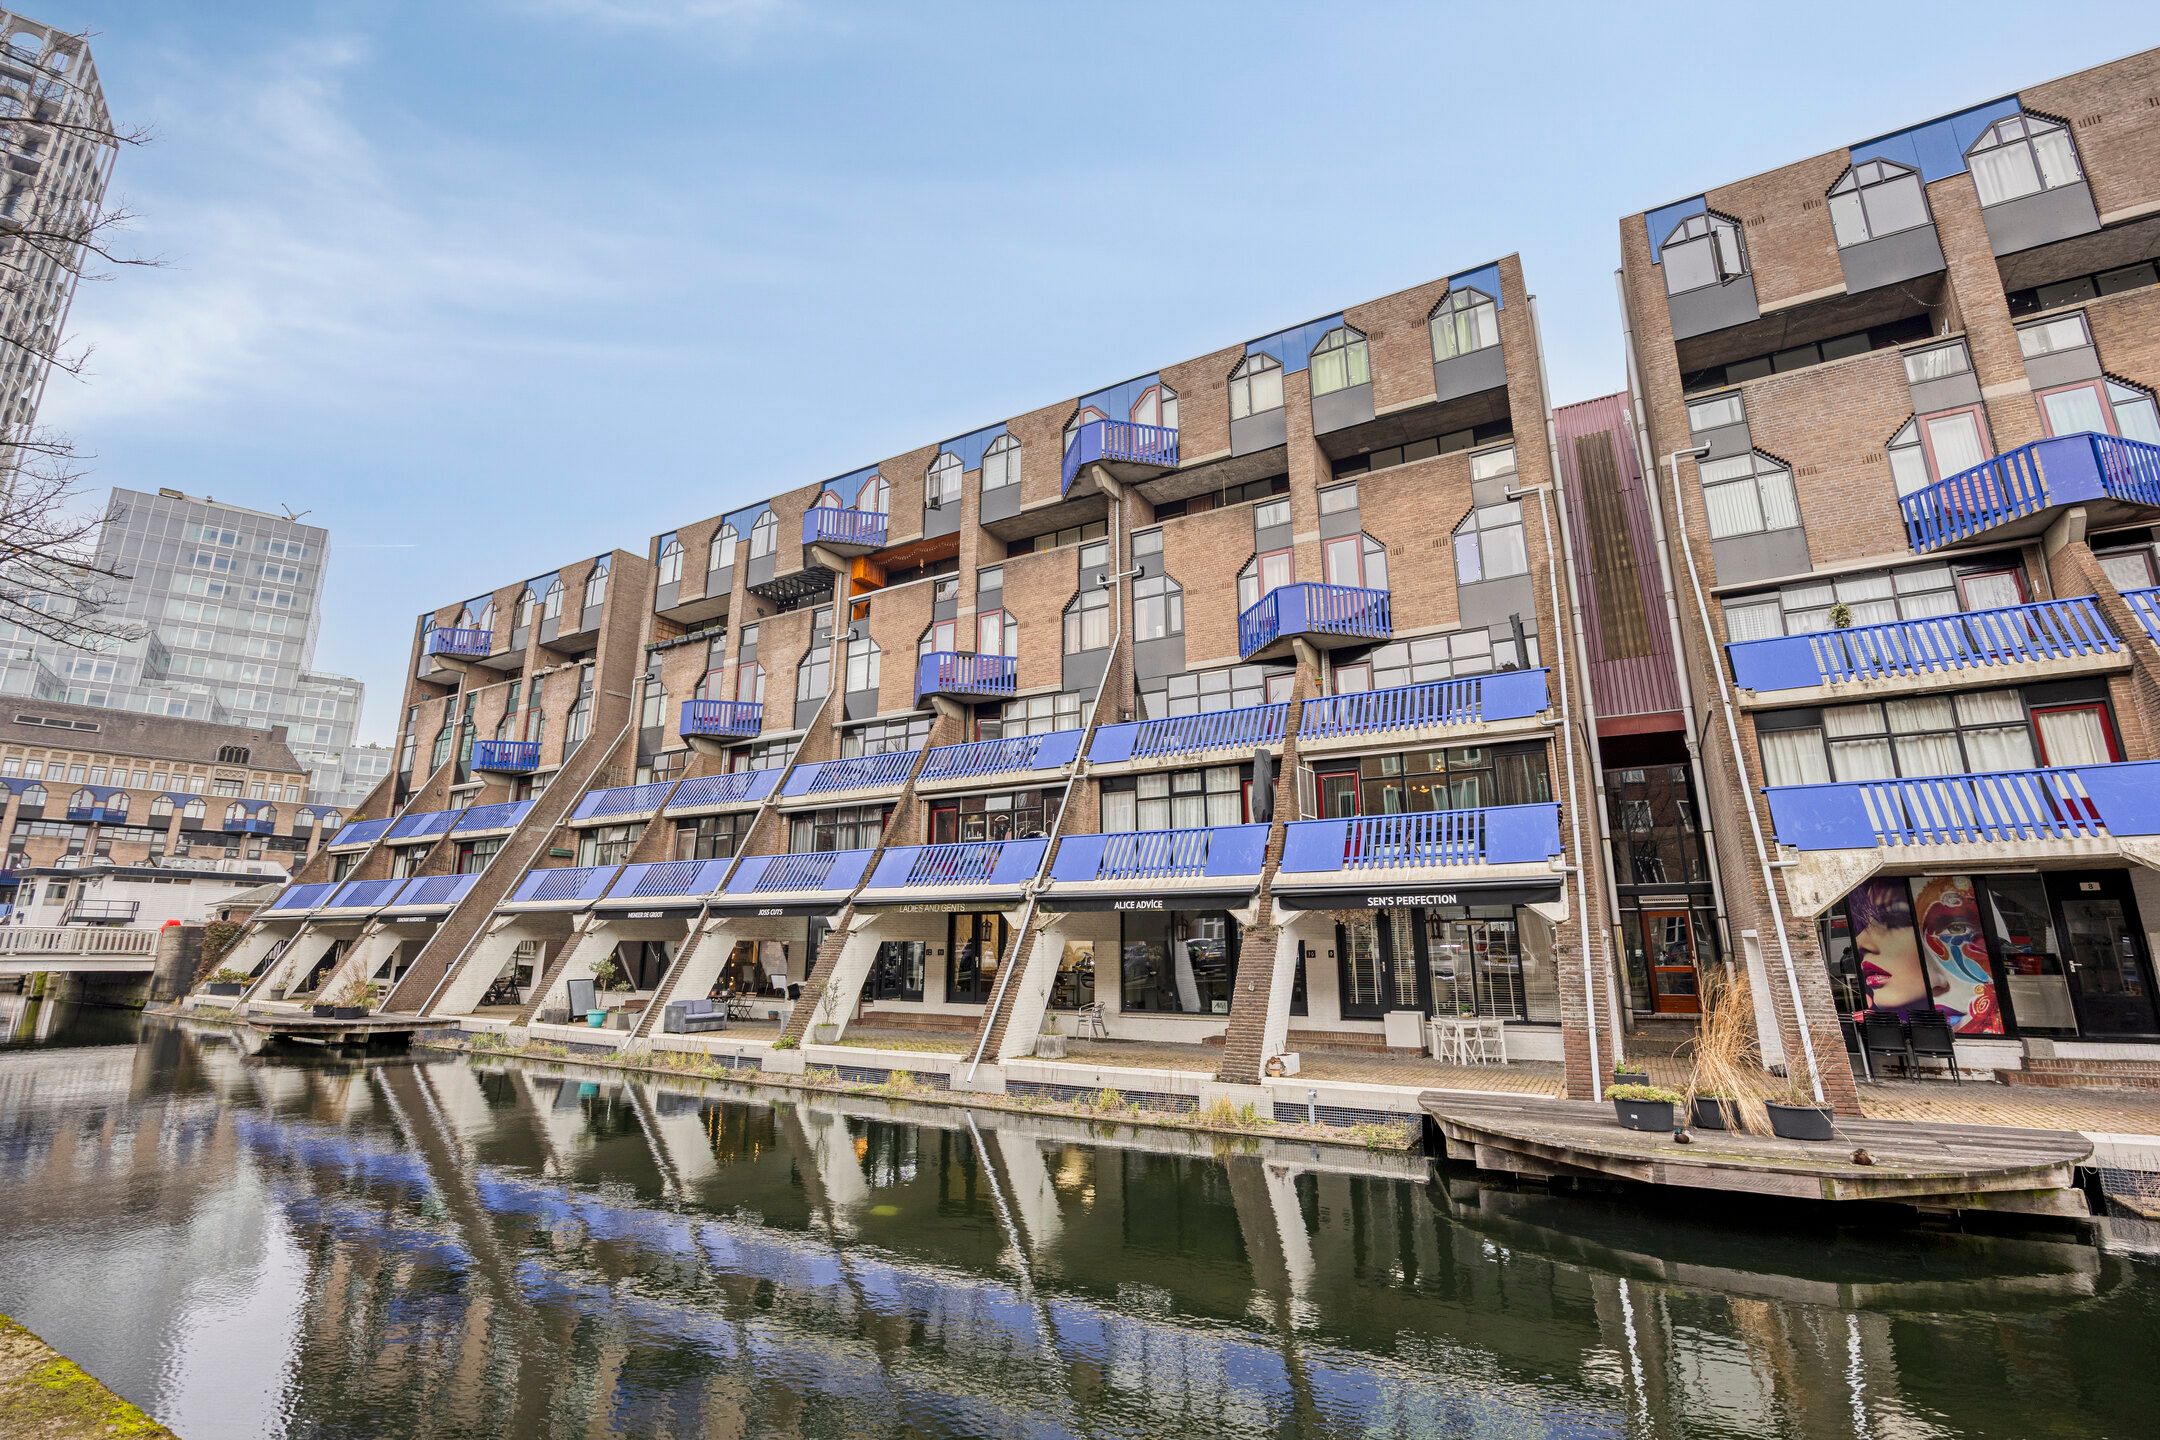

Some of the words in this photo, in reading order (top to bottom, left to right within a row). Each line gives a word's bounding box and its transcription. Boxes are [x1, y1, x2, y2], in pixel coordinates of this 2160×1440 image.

[1367, 897, 1394, 906] SEN'S
[1396, 894, 1457, 905] PERFECTION
[899, 904, 923, 912] LADIES
[924, 904, 940, 912] AND
[941, 903, 966, 912] GENTS
[1114, 901, 1135, 909] ALICE
[758, 908, 770, 916] JOSS
[770, 908, 783, 916] CUTS
